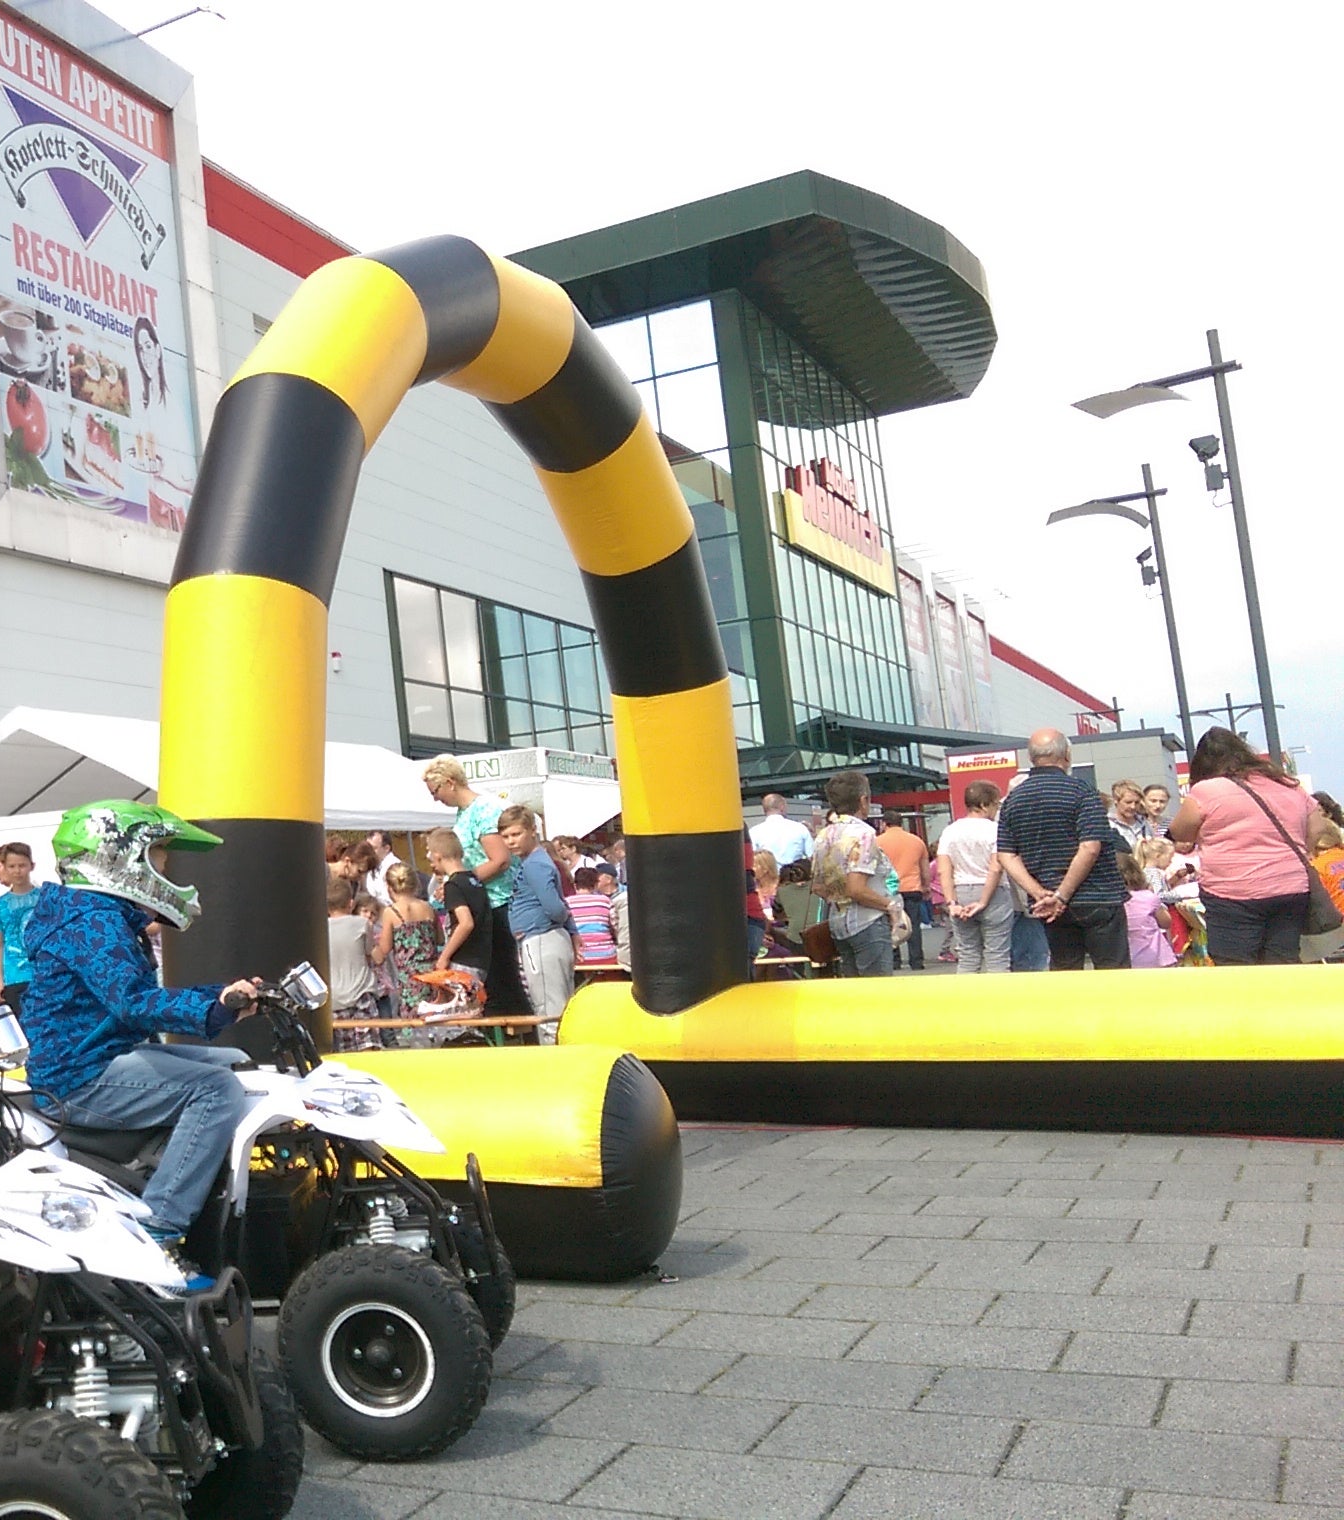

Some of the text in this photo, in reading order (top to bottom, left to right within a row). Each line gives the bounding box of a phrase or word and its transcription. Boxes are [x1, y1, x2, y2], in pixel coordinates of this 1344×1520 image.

[69, 66, 155, 149] APPETIT
[12, 222, 158, 327] RESTAURANT
[17, 277, 36, 298] mit
[37, 284, 62, 308] über
[63, 294, 82, 316] 200
[957, 757, 1009, 769] Heinrich
